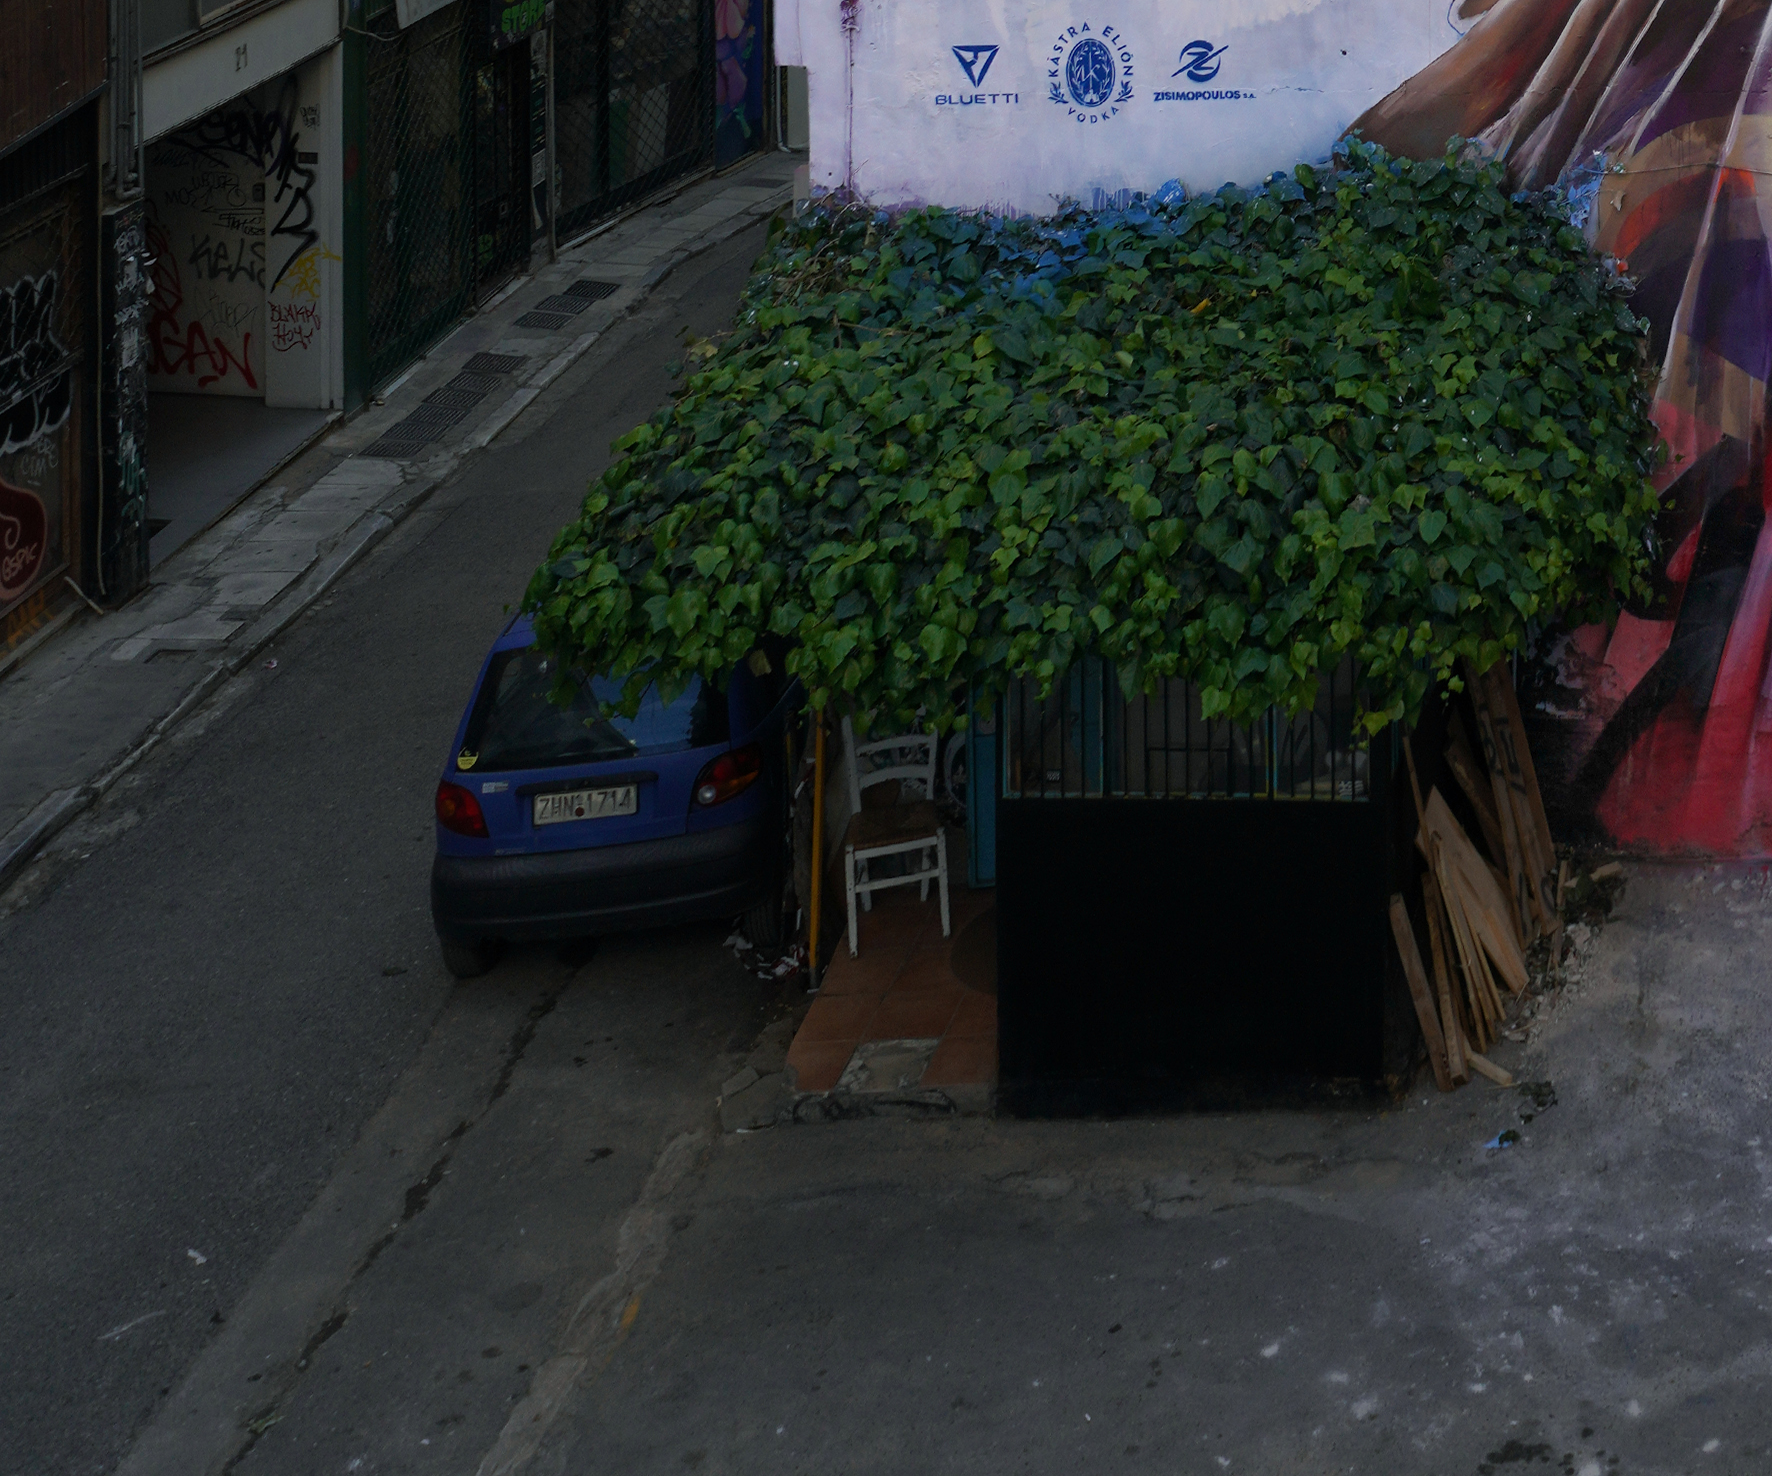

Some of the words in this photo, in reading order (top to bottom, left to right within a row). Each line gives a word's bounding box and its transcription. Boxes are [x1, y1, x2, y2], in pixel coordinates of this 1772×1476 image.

[935, 93, 1019, 105] BLUETTI
[1153, 90, 1241, 102] ZISIMOPOULOS
[1068, 106, 1120, 124] VODKA
